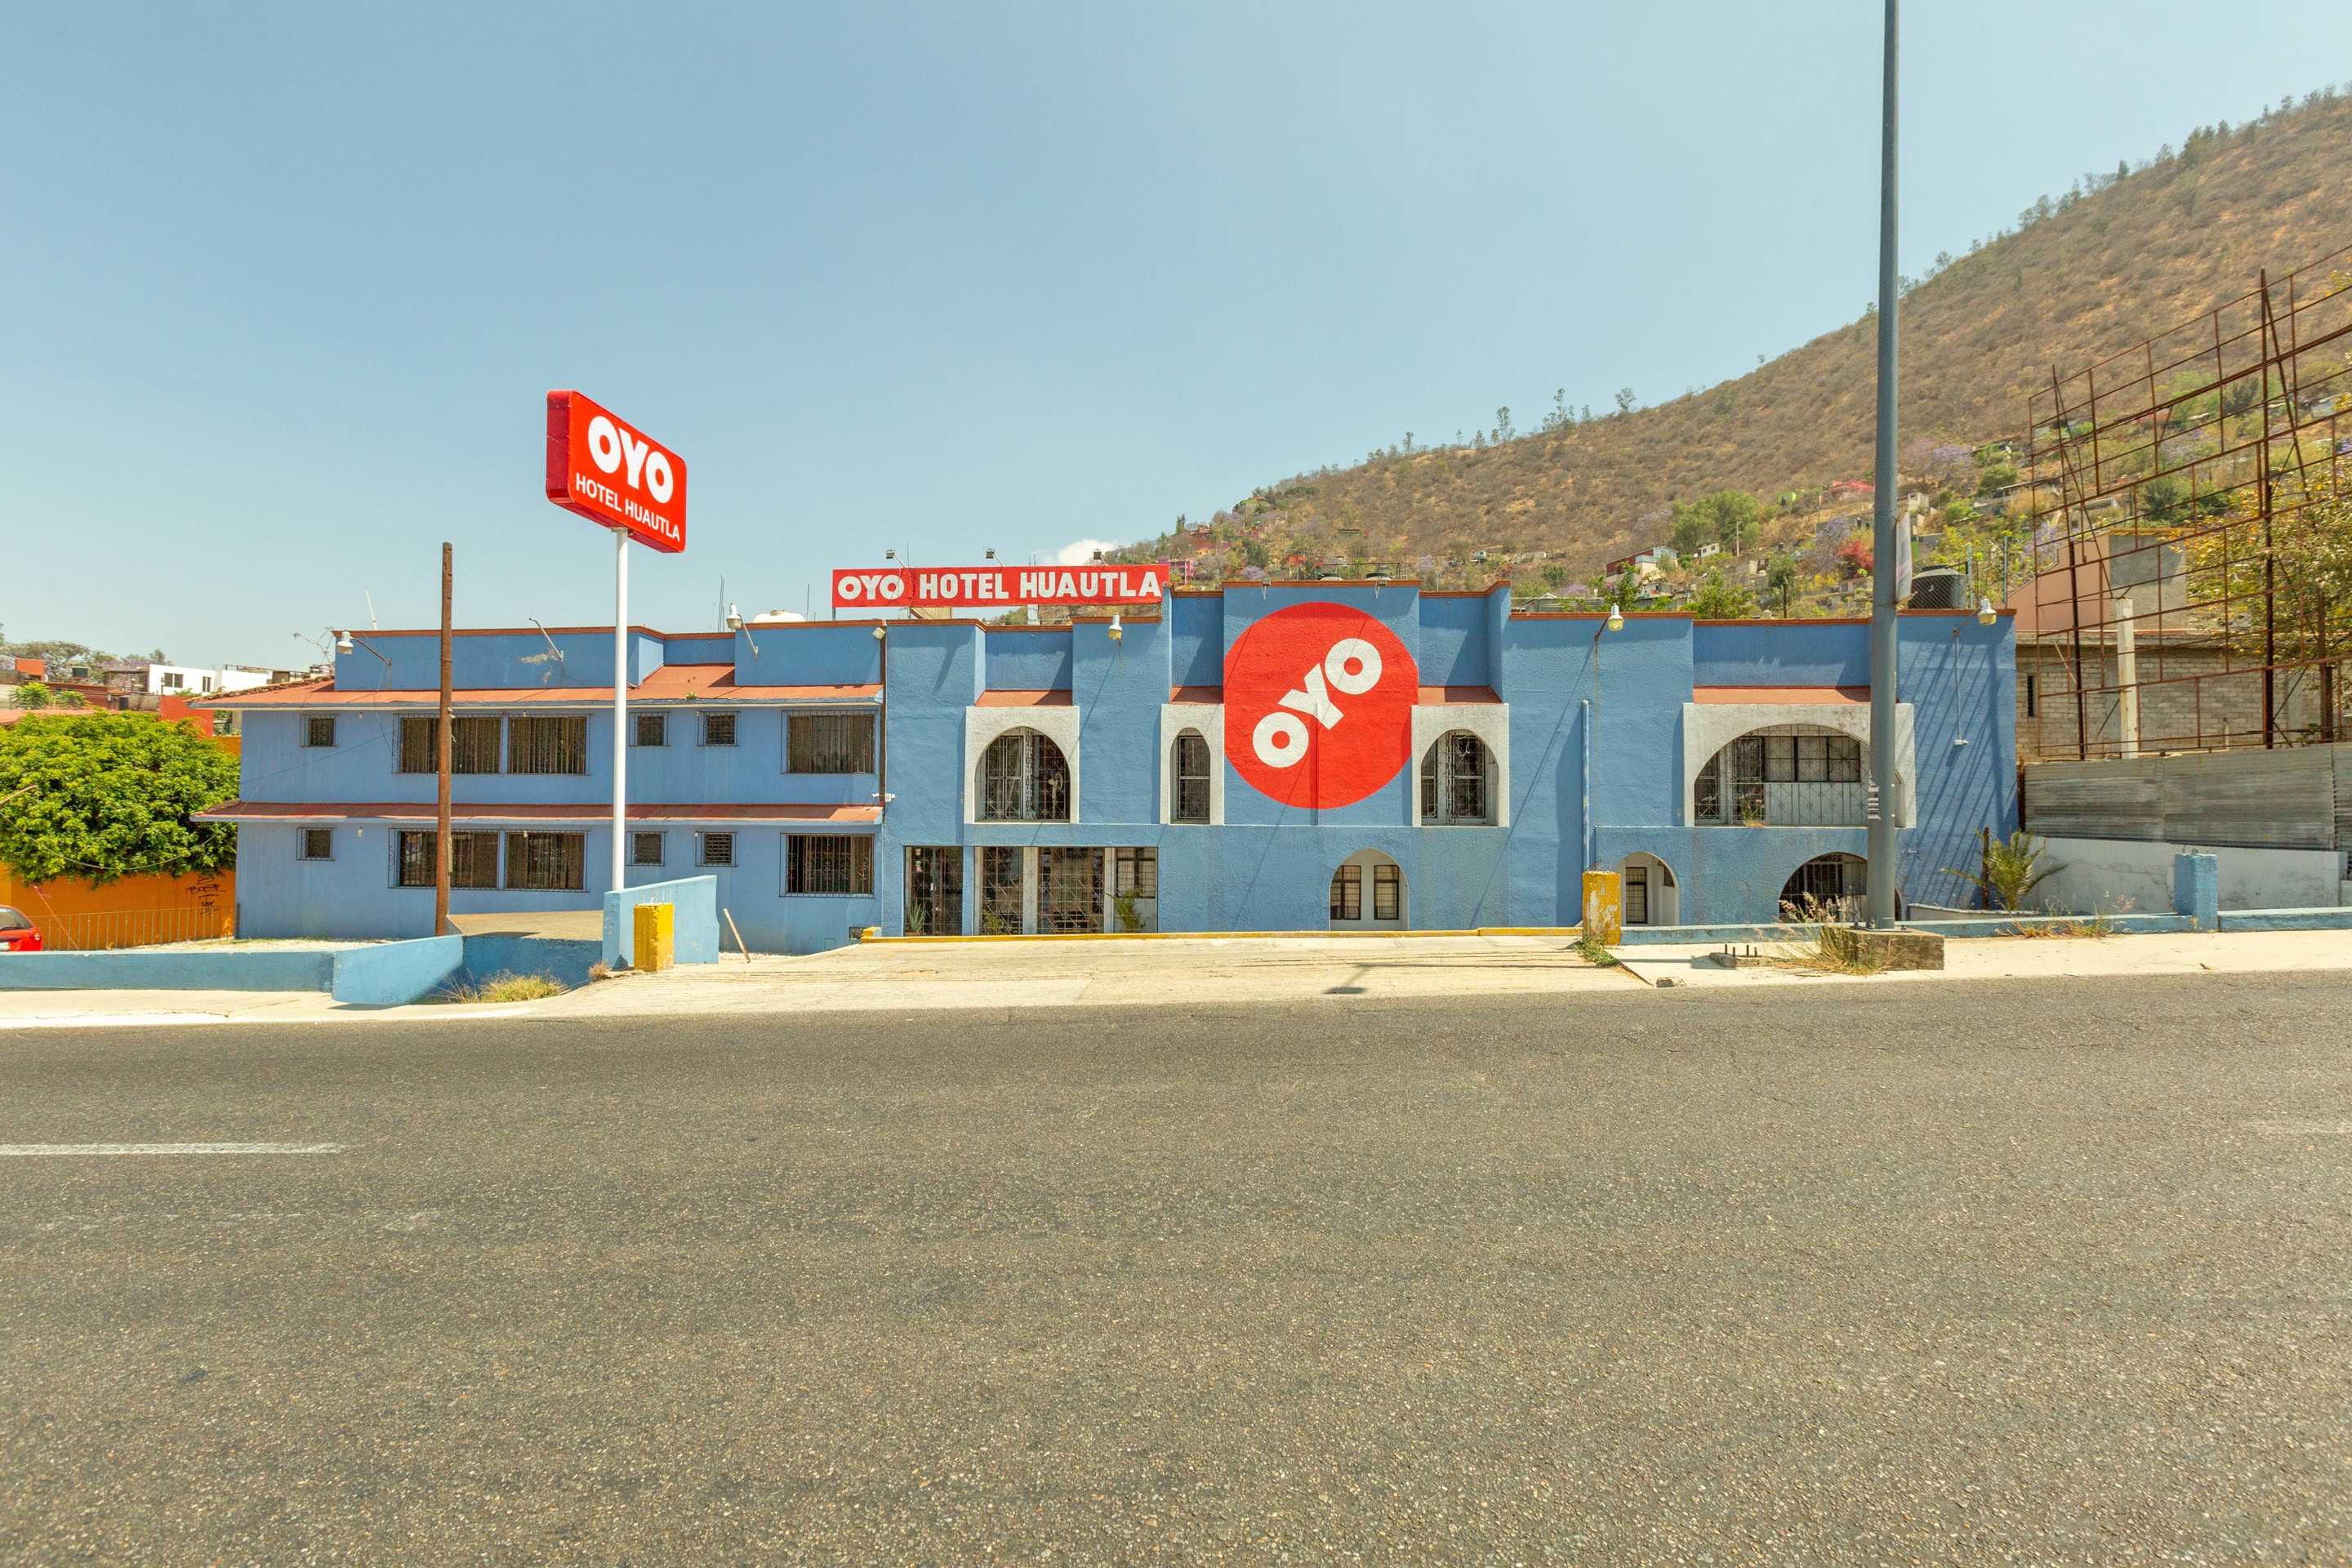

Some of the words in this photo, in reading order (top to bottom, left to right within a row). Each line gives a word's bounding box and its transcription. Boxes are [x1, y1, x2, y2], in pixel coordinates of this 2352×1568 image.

[588, 416, 674, 504] OYO
[576, 472, 622, 512] HOTEL
[625, 498, 680, 541] HUAUTLA
[837, 574, 905, 600] OYO
[920, 572, 1009, 599] HOTEL
[1020, 571, 1162, 599] HUAUTLA
[1252, 638, 1383, 768] OYO
